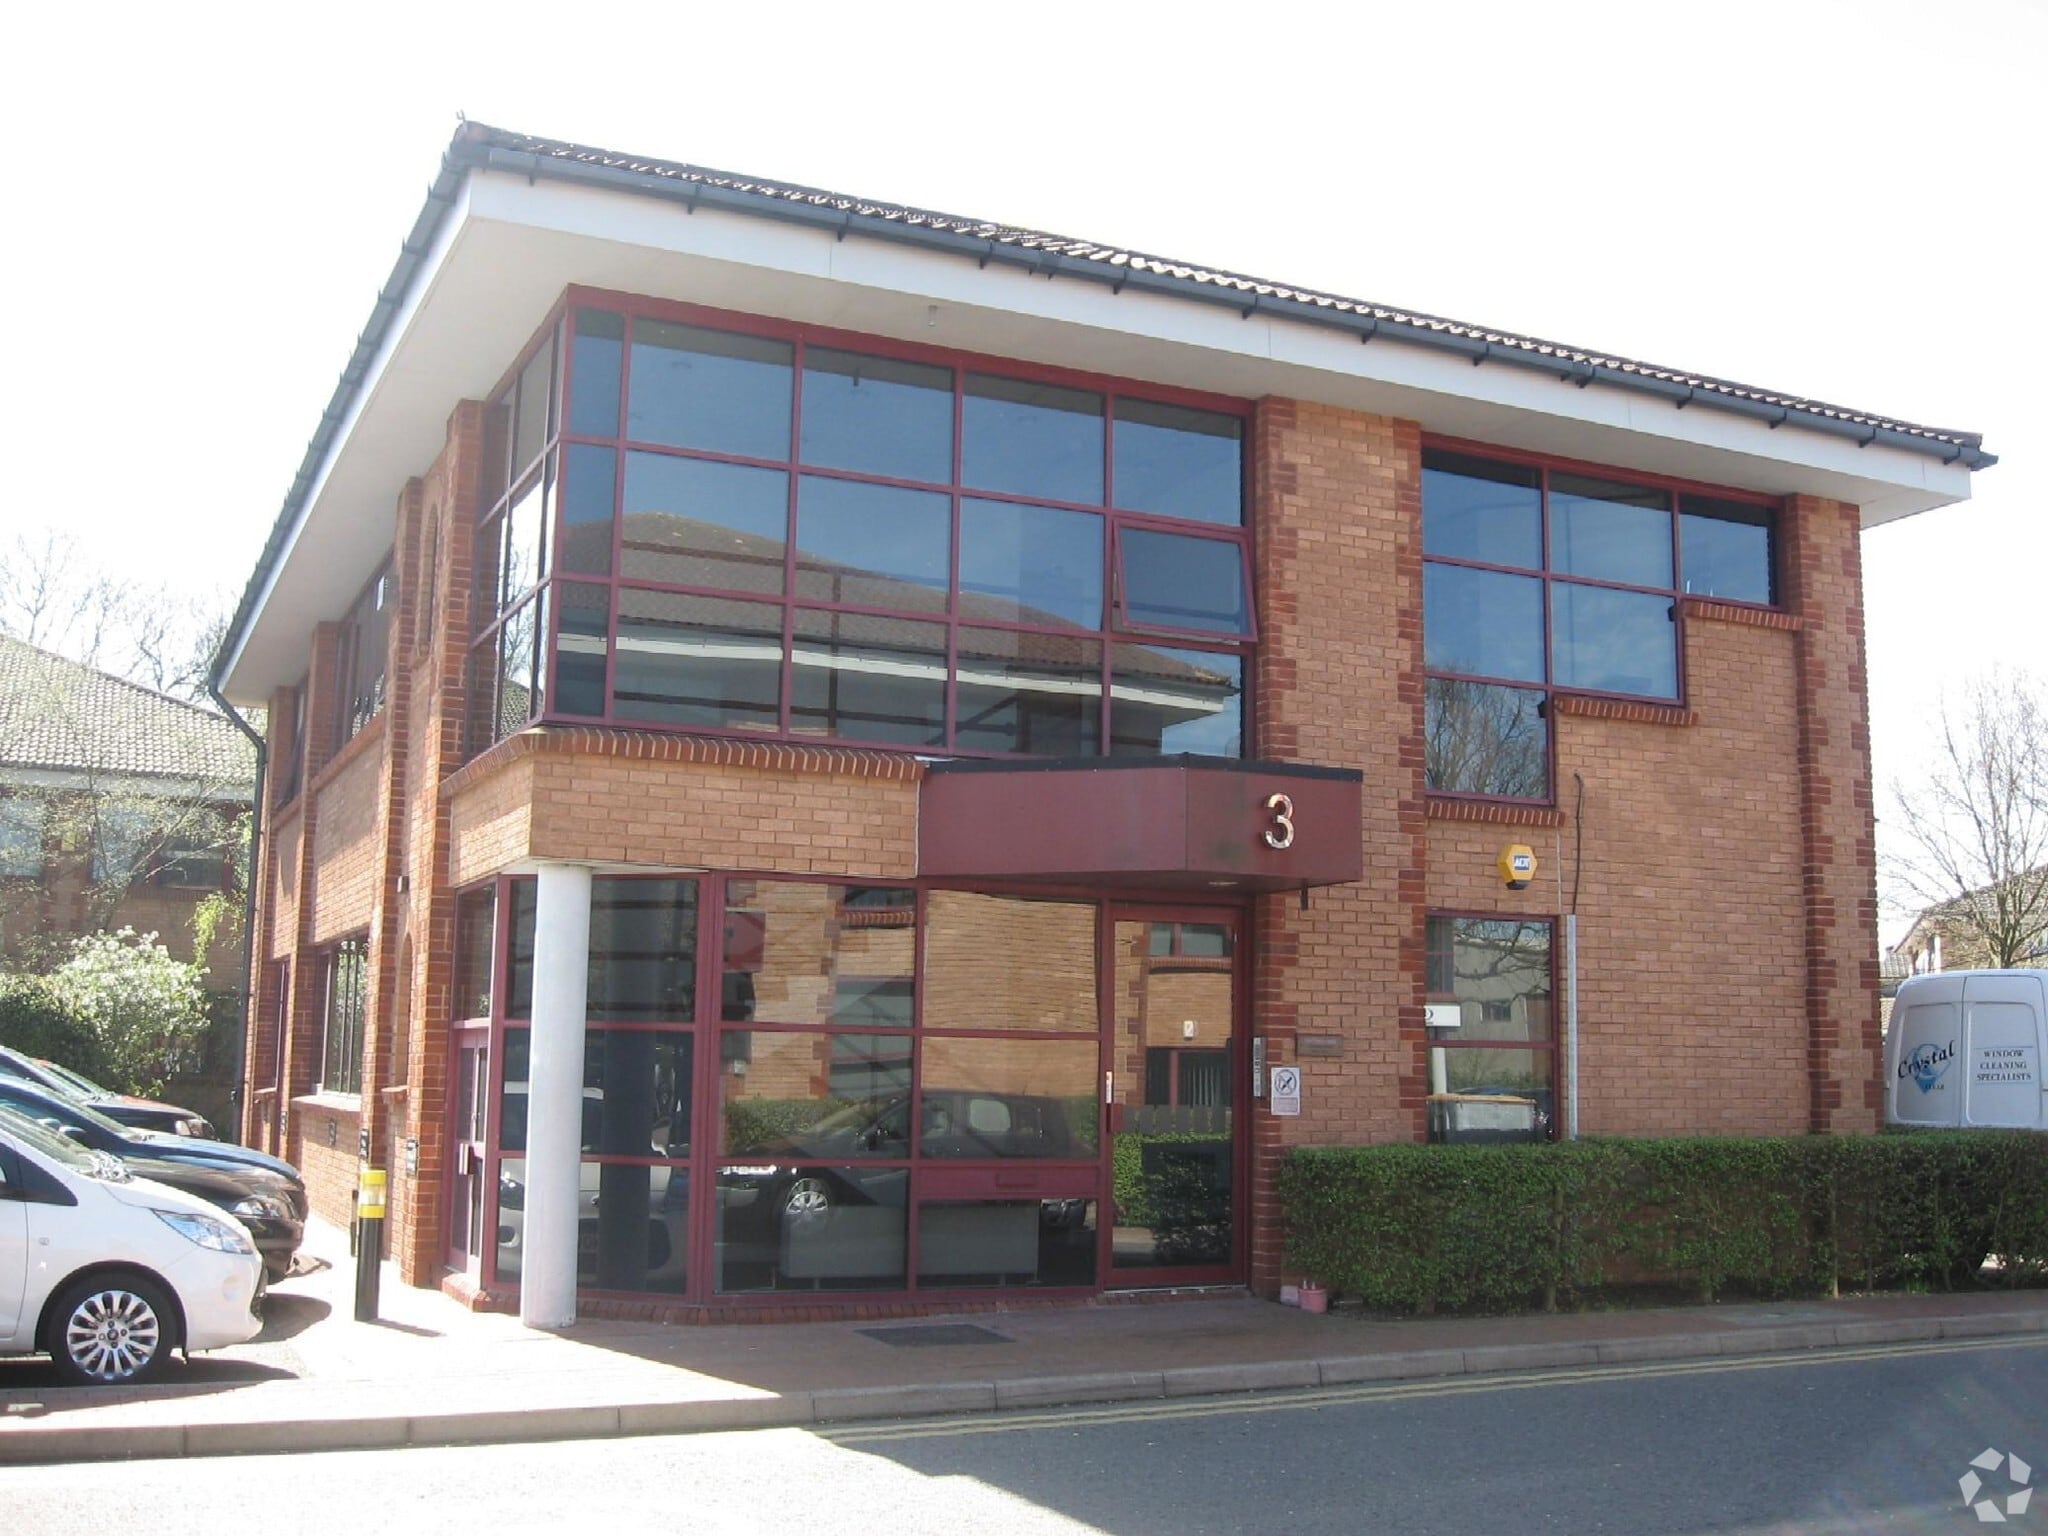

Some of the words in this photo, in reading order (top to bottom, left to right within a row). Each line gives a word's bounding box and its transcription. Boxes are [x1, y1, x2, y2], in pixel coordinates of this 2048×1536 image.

[1264, 793, 1295, 849] 3
[1983, 1049, 2024, 1057] WINDOW
[1898, 1040, 1955, 1079] Crystal
[1979, 1061, 2027, 1070] CLEANING
[1976, 1073, 2032, 1081] SPECIALISTS
